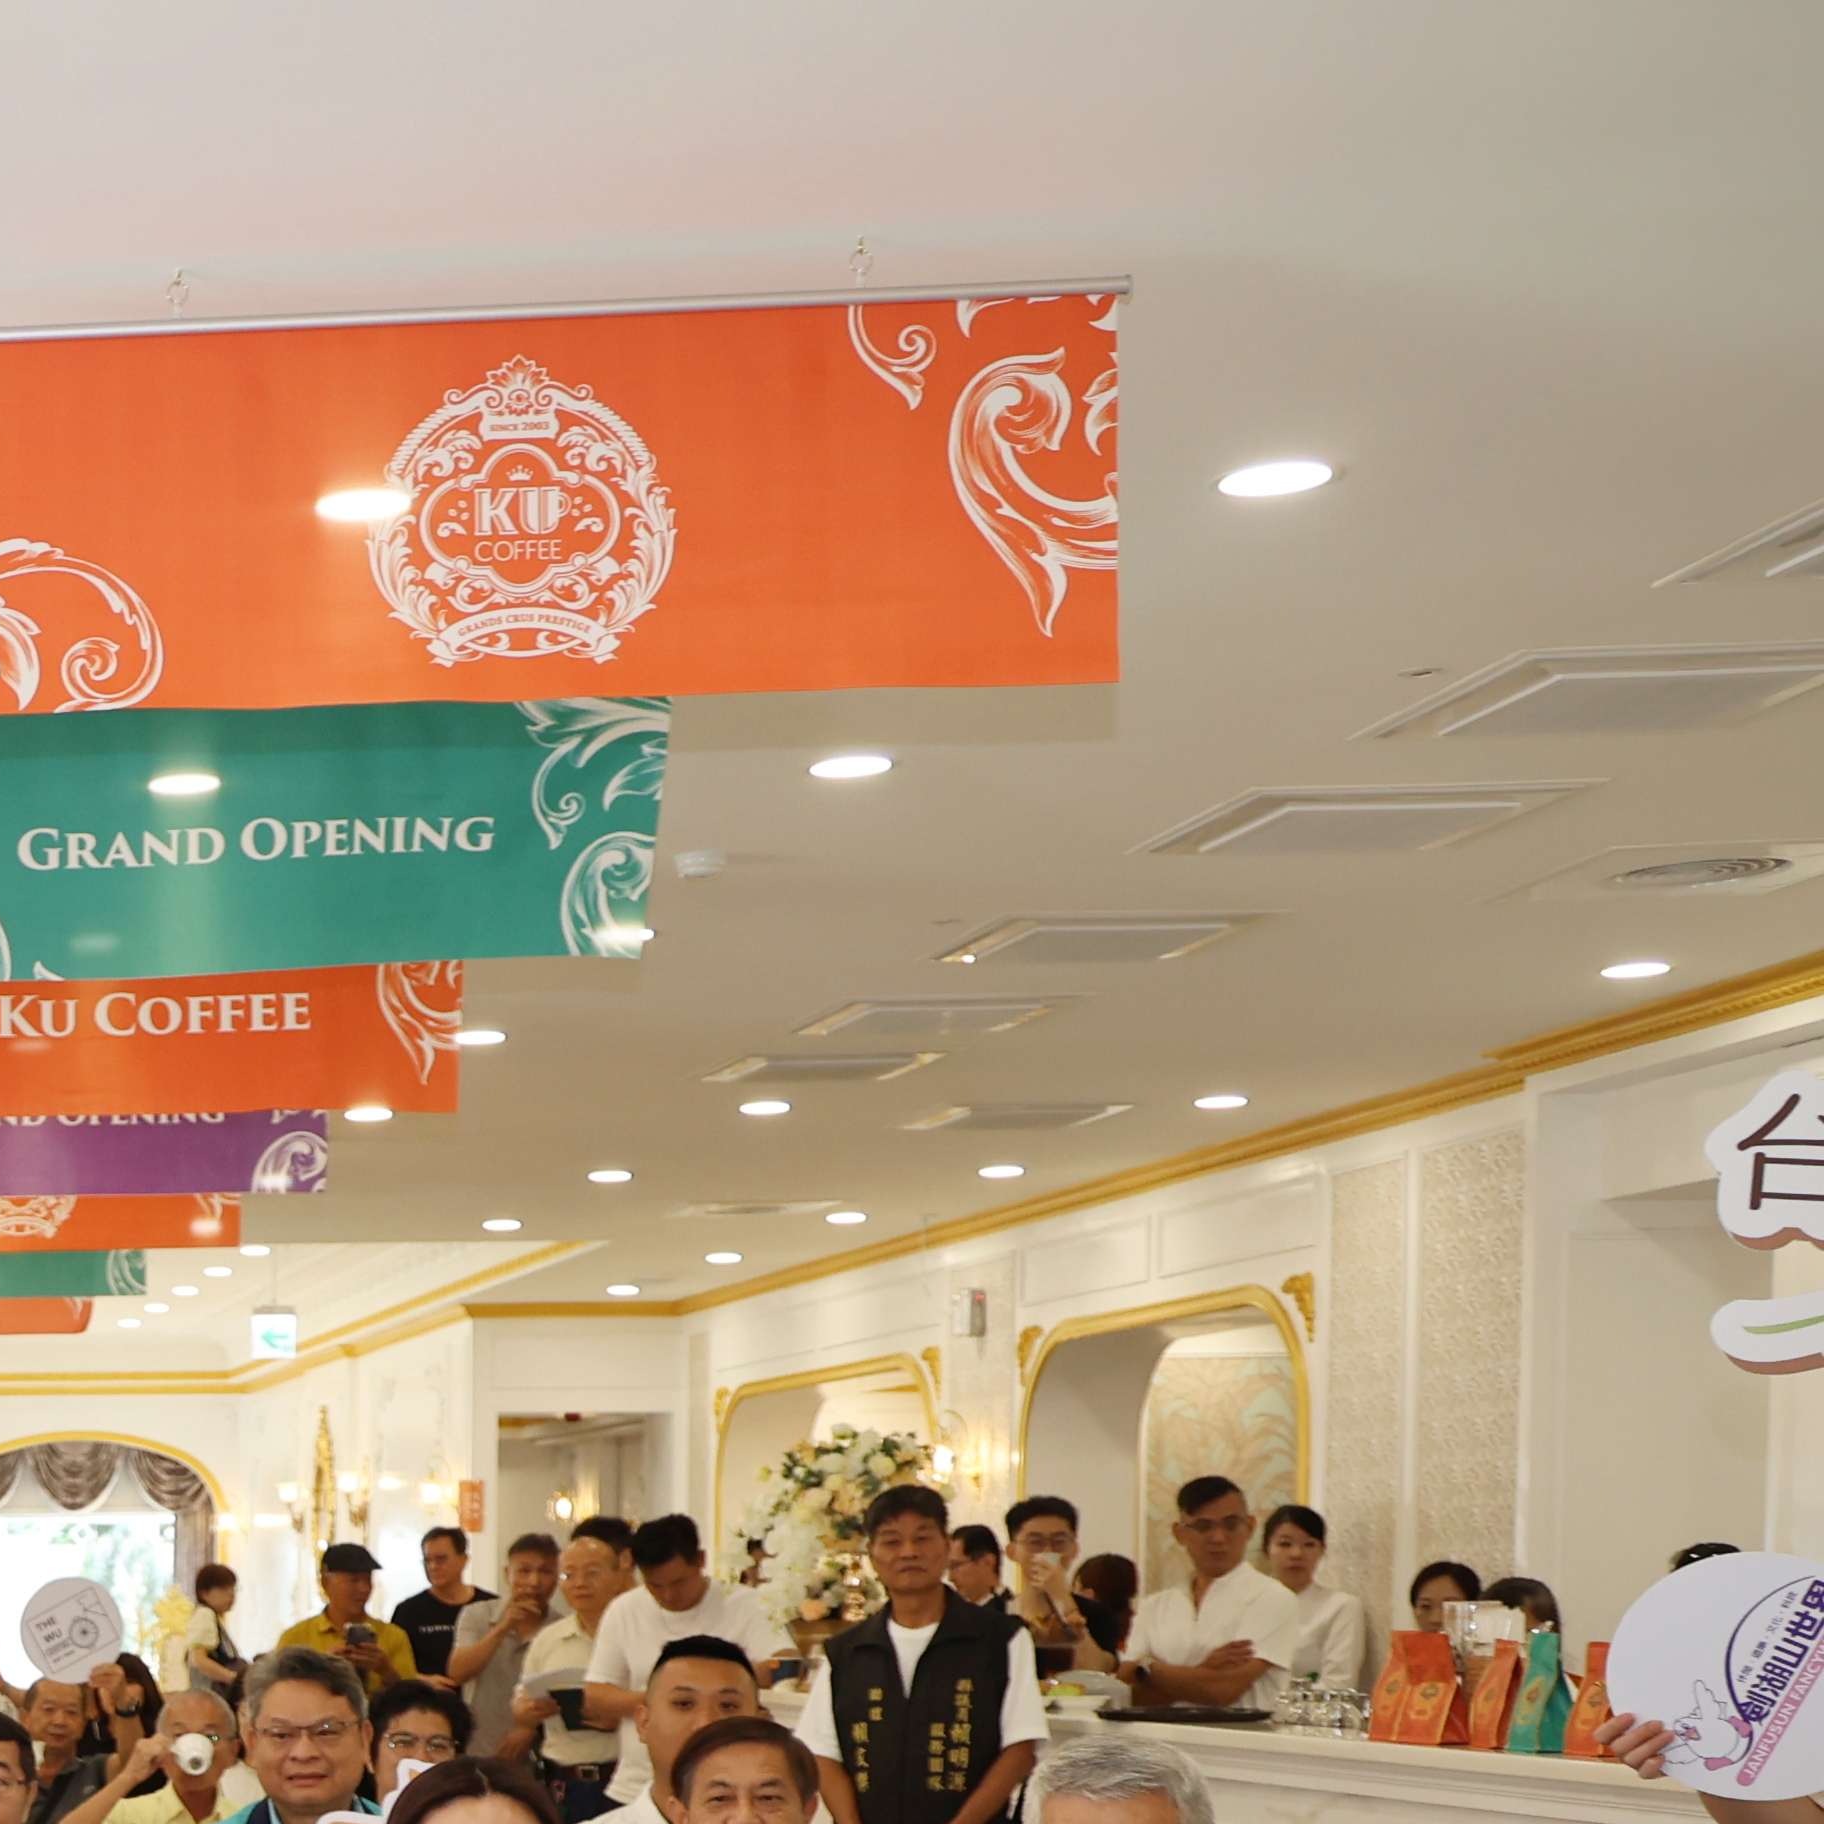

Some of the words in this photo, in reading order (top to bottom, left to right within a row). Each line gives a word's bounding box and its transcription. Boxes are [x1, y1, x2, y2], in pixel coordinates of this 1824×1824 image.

[474, 539, 563, 562] COFFEE
[537, 612, 592, 633] PRESTIGE
[17, 827, 226, 871] GRAND
[240, 816, 496, 861] OPENING
[93, 992, 312, 1037] COFFEE
